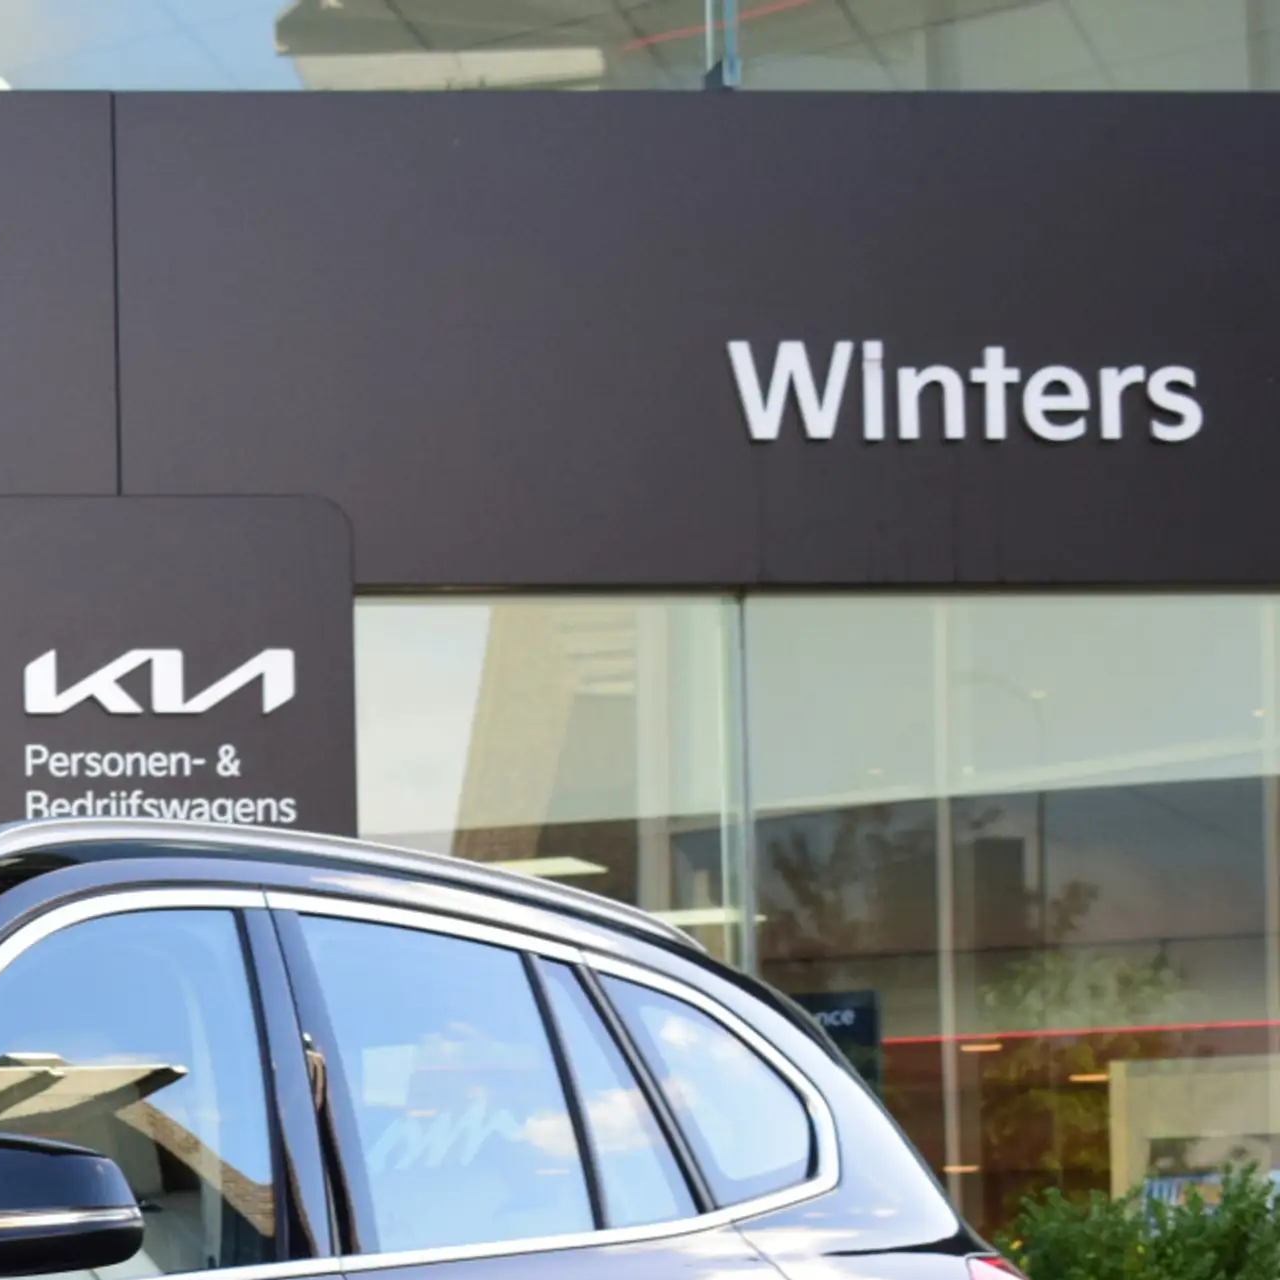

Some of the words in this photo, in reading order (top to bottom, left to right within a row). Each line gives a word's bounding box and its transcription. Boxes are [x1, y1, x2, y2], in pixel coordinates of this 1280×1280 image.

[727, 340, 1203, 441] Winters
[24, 648, 296, 714] KIA
[24, 744, 206, 777] Personen-
[215, 744, 242, 777] &
[25, 789, 297, 824] Bedrijfswagens
